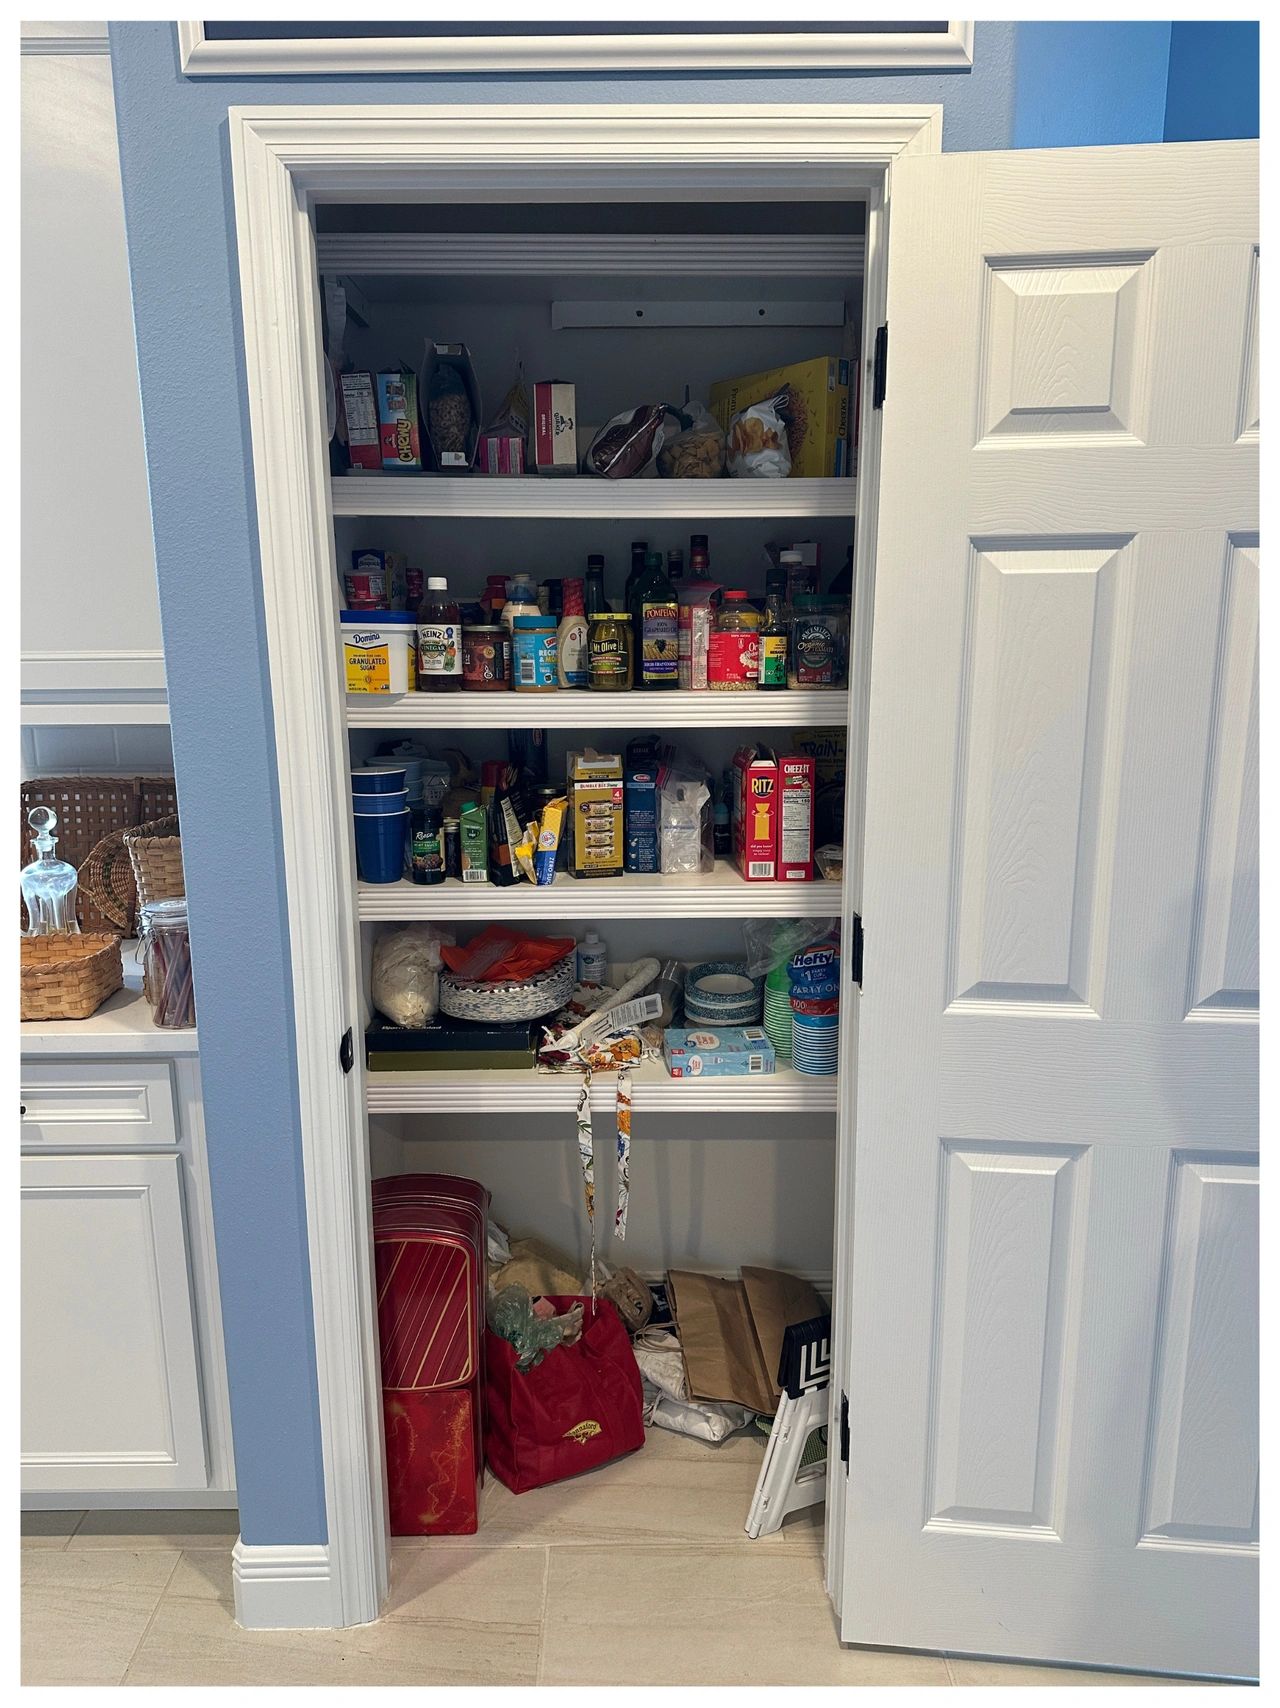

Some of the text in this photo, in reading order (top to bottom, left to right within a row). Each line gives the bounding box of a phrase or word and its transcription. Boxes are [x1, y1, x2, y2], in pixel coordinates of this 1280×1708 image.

[838, 397, 848, 438] Cheerios
[646, 608, 676, 618] POMPEIAN
[353, 632, 380, 644] Domino
[422, 630, 442, 639] HEINZ
[601, 642, 617, 652] Olive
[798, 642, 826, 652] Organic
[752, 778, 774, 793] RITZ
[415, 831, 434, 840] Reese
[794, 952, 832, 966] Hefty
[793, 984, 821, 994] PARTY
[792, 1000, 806, 1009] 100
